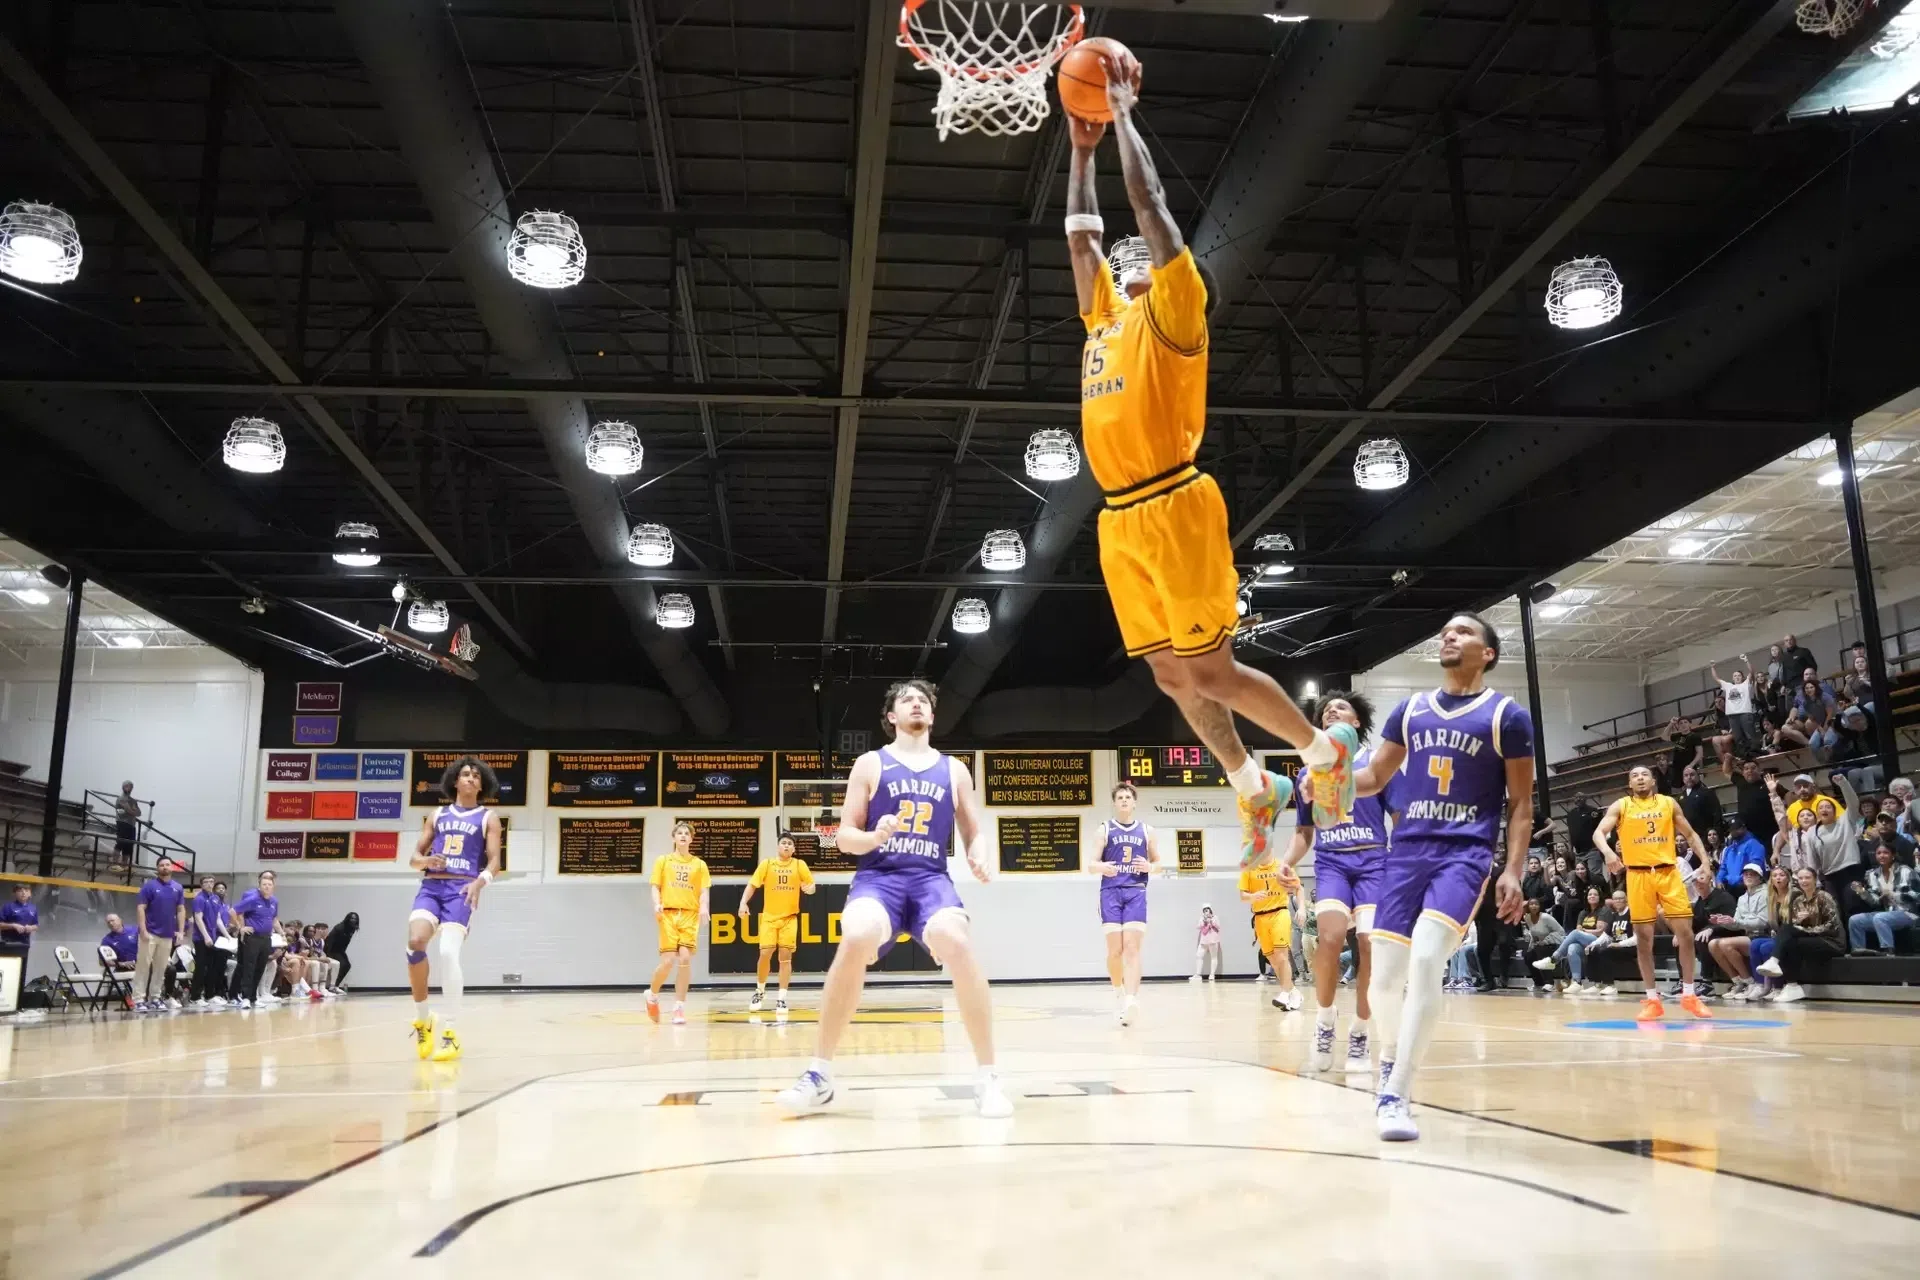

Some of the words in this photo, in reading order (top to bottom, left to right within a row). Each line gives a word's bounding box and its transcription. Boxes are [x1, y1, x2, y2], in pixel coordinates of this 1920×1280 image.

[1084, 346, 1107, 379] 15
[302, 693, 335, 702] McMurry
[300, 726, 332, 735] Ozarks
[1412, 728, 1484, 757] HARDIN
[364, 758, 402, 767] University
[1168, 748, 1200, 766] 19.3
[271, 760, 308, 768] Centenary
[993, 759, 1015, 769] TEXAS
[1016, 759, 1051, 769] LUTHERAN
[1052, 758, 1084, 769] COLLEGE
[1130, 758, 1152, 776] 68
[276, 770, 302, 778] College
[988, 775, 1002, 786] HOT
[1003, 774, 1048, 785] CONFERENCE
[1049, 774, 1088, 785] CO-CHAMPS
[1183, 770, 1192, 783] 2
[1428, 754, 1454, 796] 4
[591, 777, 616, 786] SCAC
[704, 776, 730, 786] SCAC
[887, 778, 946, 802] HARDIN
[992, 790, 1012, 801] MEN'S
[1014, 790, 1058, 801] BASKETBALL
[277, 806, 303, 814] College
[1406, 800, 1478, 824] SIMMONS
[898, 800, 934, 836] 22
[438, 822, 478, 836] HARDIN
[1646, 821, 1656, 834] 3
[1112, 834, 1143, 846] HARDIN
[1320, 826, 1374, 844] SIMMONS
[442, 834, 465, 856] 15
[262, 848, 300, 856] University
[1122, 846, 1133, 863] 3
[676, 871, 688, 882] 32
[778, 875, 788, 884] 10
